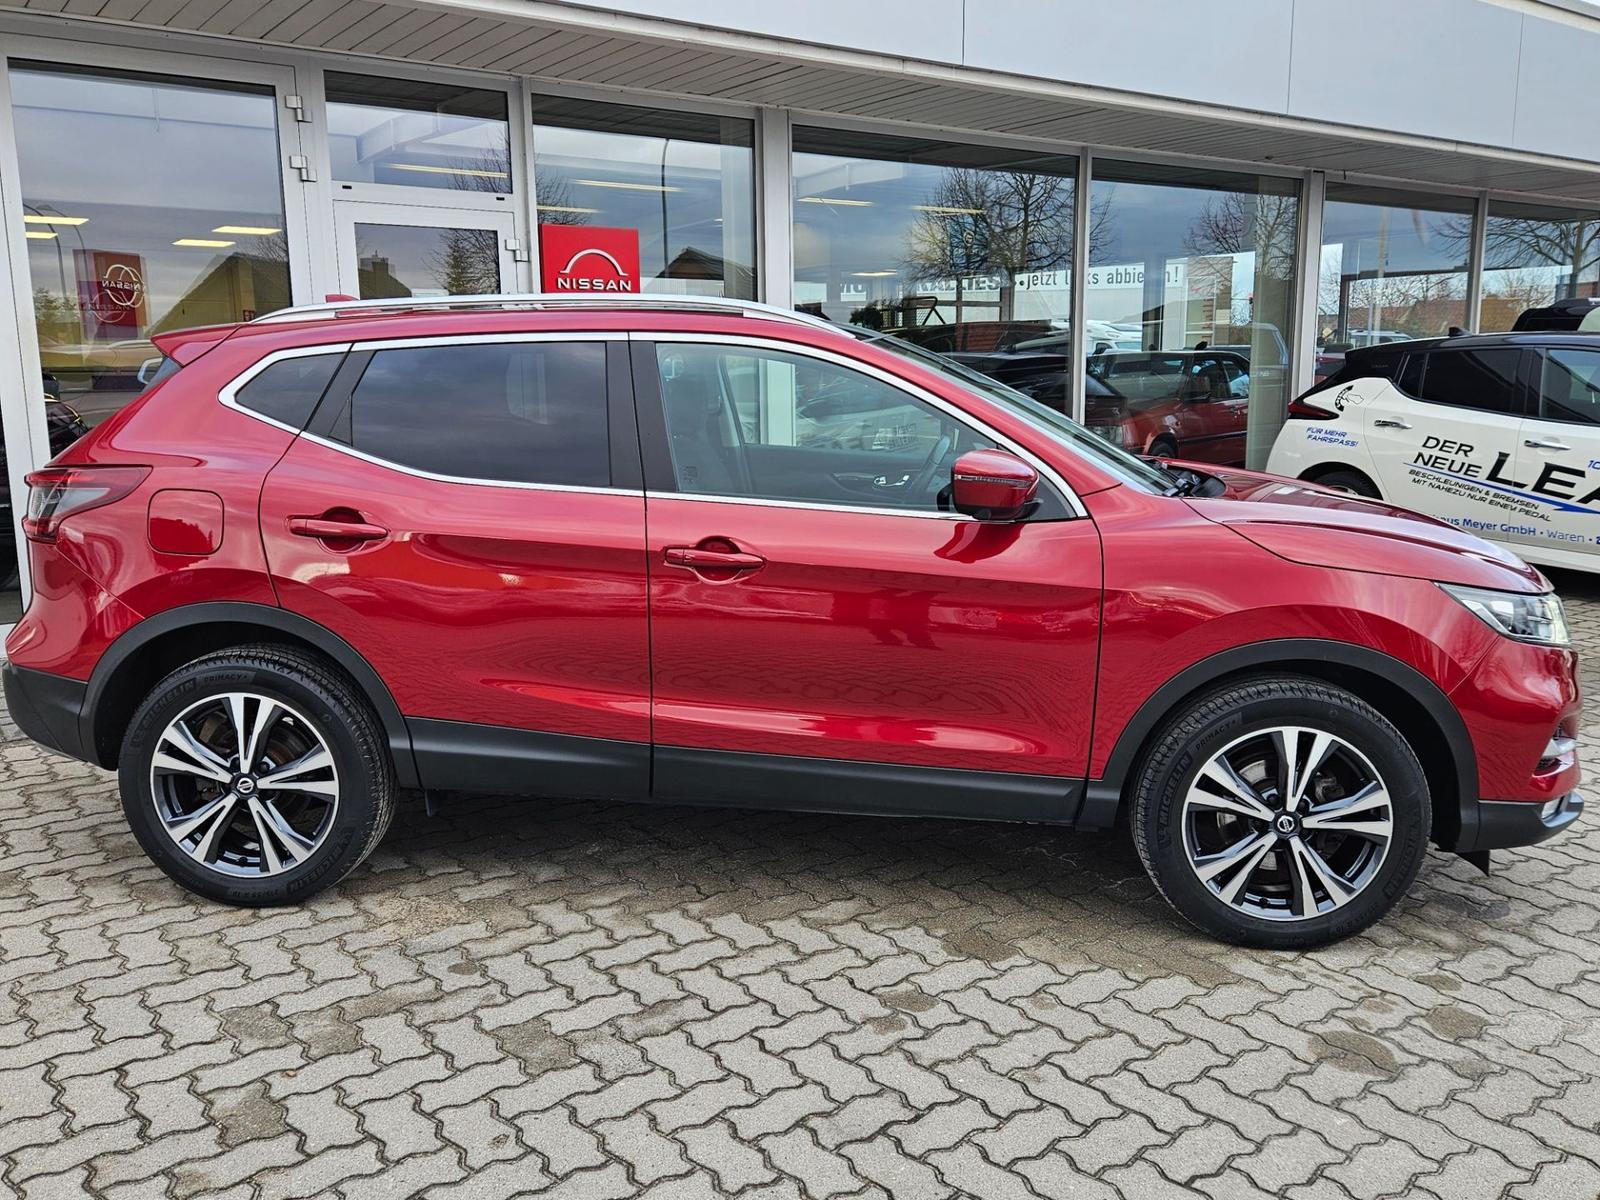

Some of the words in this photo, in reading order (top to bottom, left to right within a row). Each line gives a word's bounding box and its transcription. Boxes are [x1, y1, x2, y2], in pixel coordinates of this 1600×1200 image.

[557, 277, 632, 291] NISSAN
[1307, 434, 1359, 447] FAHRSPASS!
[1422, 435, 1474, 457] DER
[1413, 452, 1482, 478] NEUE
[1408, 469, 1483, 494] BESCHLEUNIGEN
[1493, 492, 1539, 510] BREMSEN
[1412, 478, 1427, 486] MIT
[1428, 481, 1466, 497] NAHEZU
[1467, 493, 1488, 503] NUR
[1518, 507, 1553, 522] PEDAL
[1463, 518, 1498, 532] Meyer
[1500, 523, 1537, 536] GmbH
[1546, 529, 1585, 543] Waren
[1158, 755, 1192, 824] MICHELIN
[1195, 721, 1231, 751] PRIMACY
